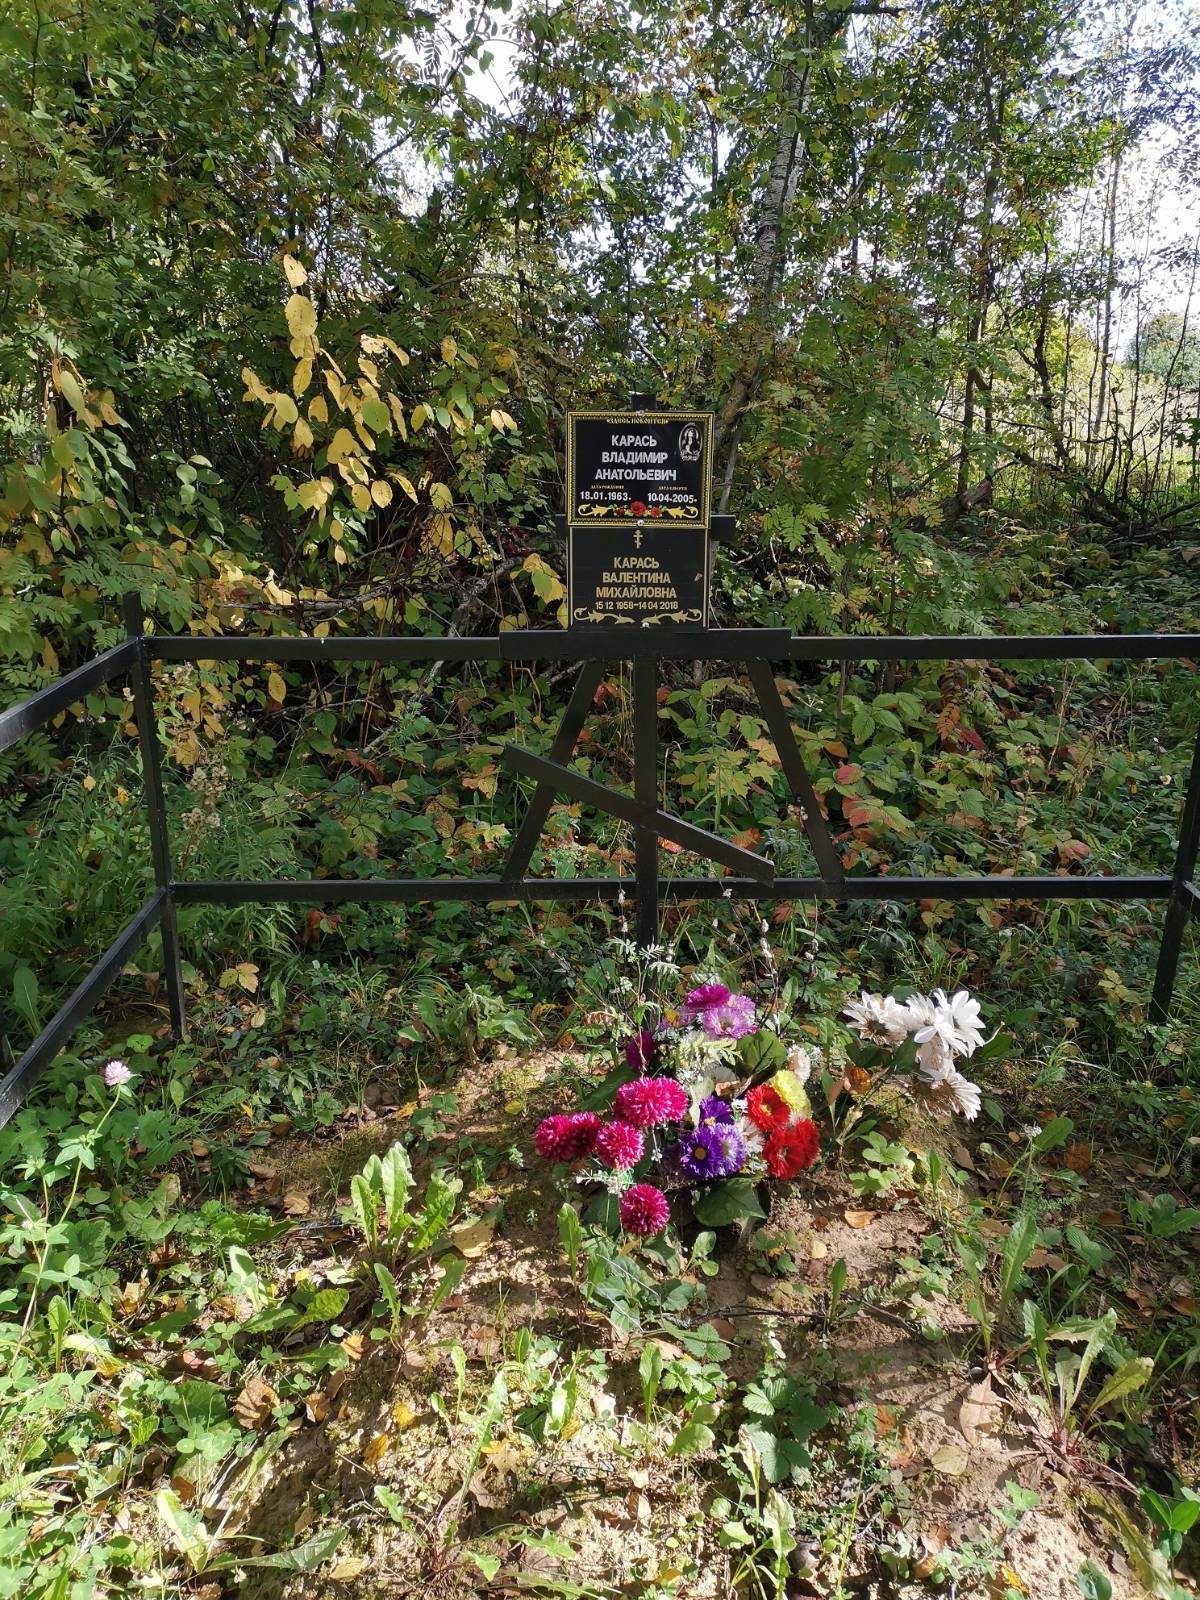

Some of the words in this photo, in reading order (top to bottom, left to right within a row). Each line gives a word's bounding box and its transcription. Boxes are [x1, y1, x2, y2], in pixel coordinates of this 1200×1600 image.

[611, 434, 657, 447] КАРАСЬ
[601, 451, 668, 465] ВЛАДИМИР
[595, 468, 677, 481] АНАТОЛЬЕВИЧ
[613, 557, 660, 569] КАРАСЬ
[602, 572, 671, 584] ВАЛЕНТИНА
[596, 585, 677, 598] МИХАЙЛОВНА
[659, 600, 679, 610] 2018
